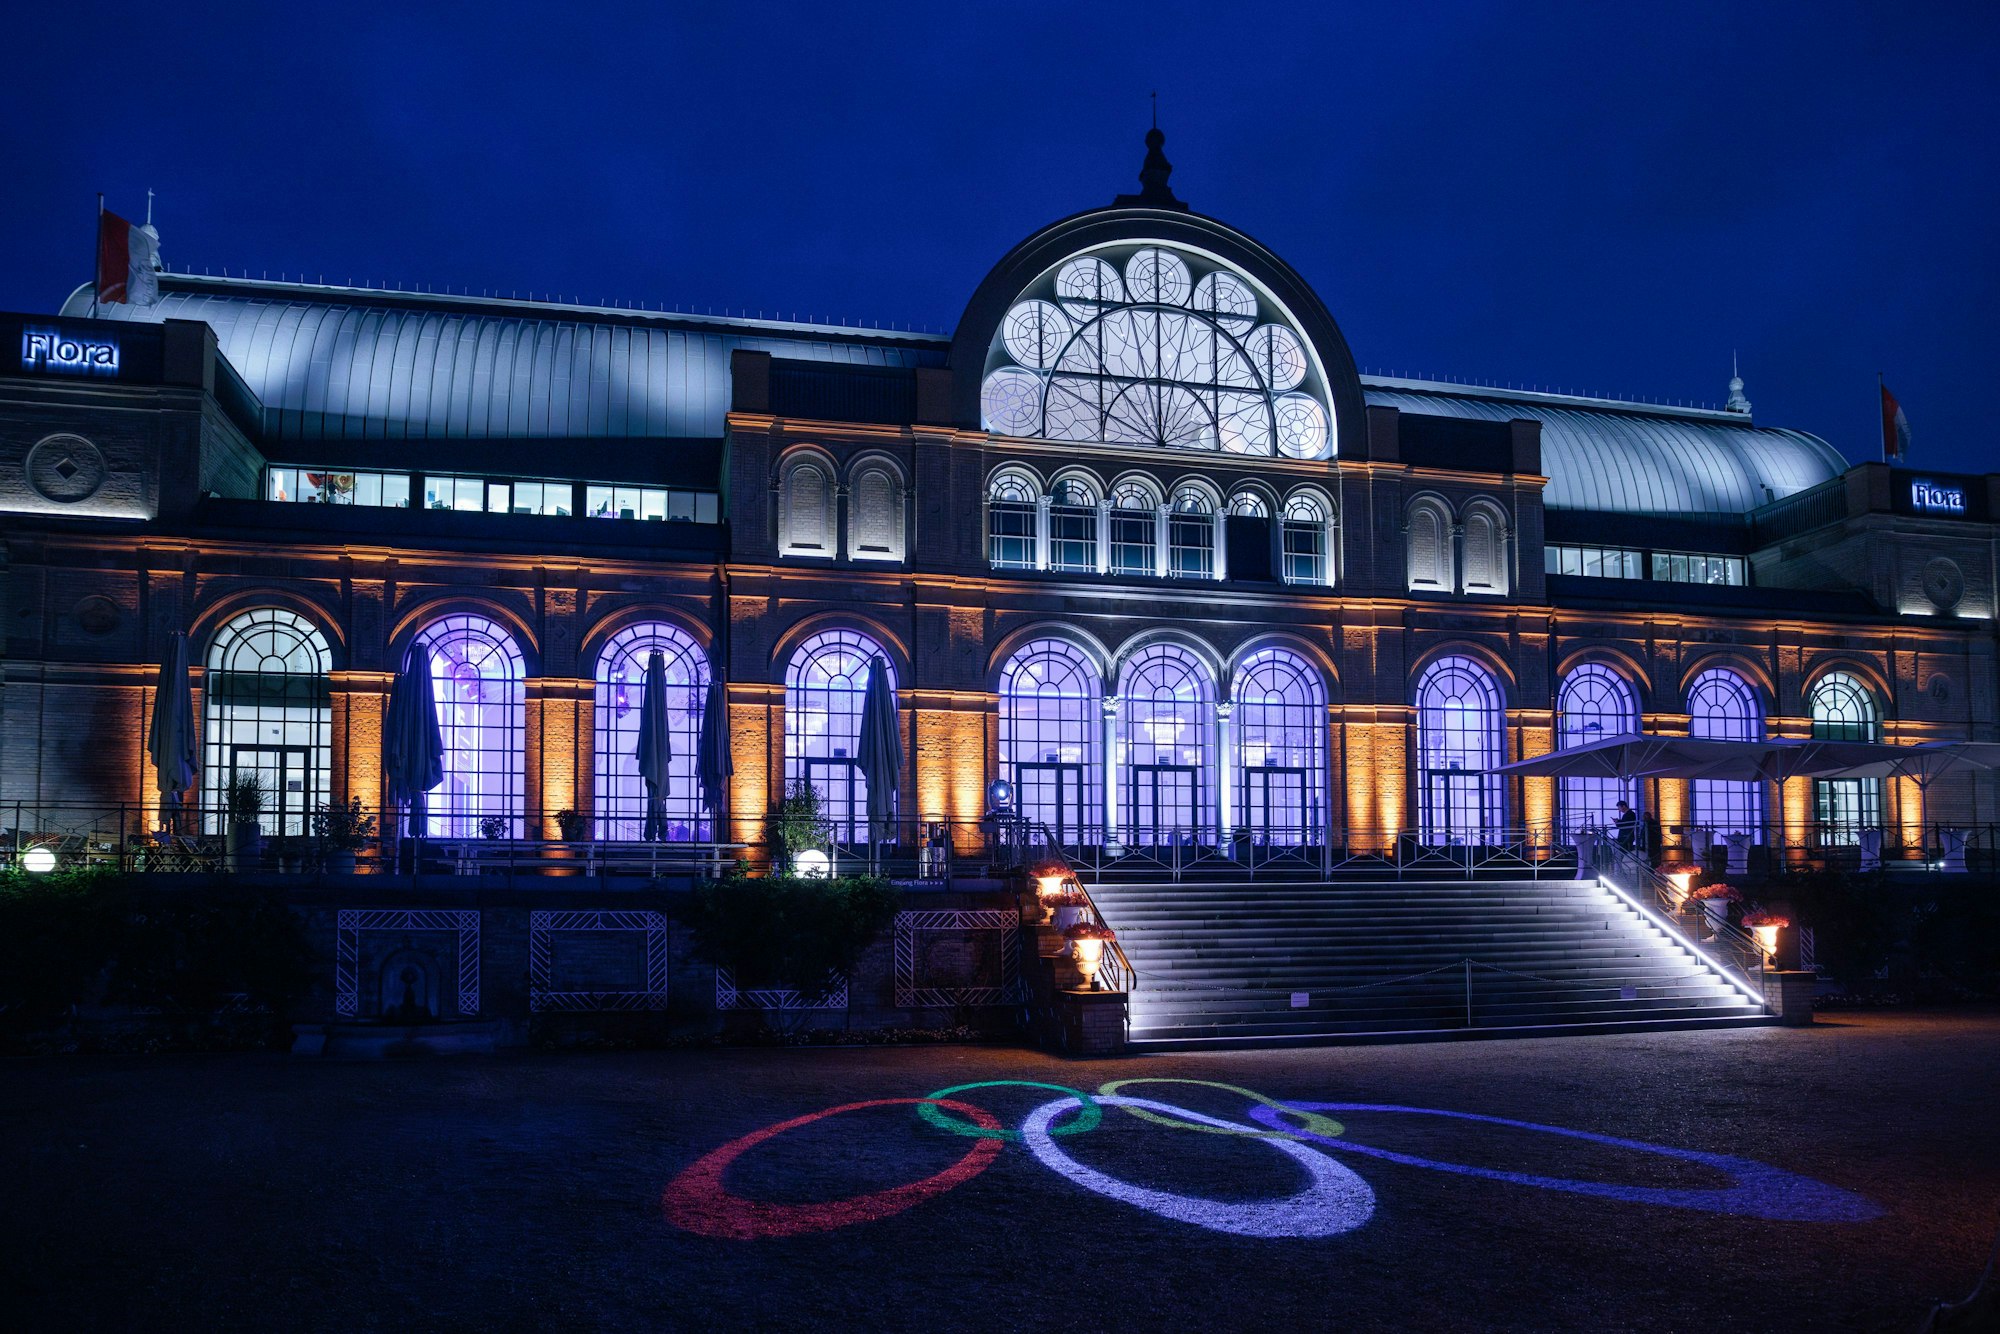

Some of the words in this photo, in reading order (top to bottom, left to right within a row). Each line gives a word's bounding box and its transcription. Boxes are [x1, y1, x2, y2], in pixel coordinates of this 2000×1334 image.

[24, 333, 116, 365] Flora
[1915, 484, 1964, 507] Flora
[890, 879, 913, 887] Eingang
